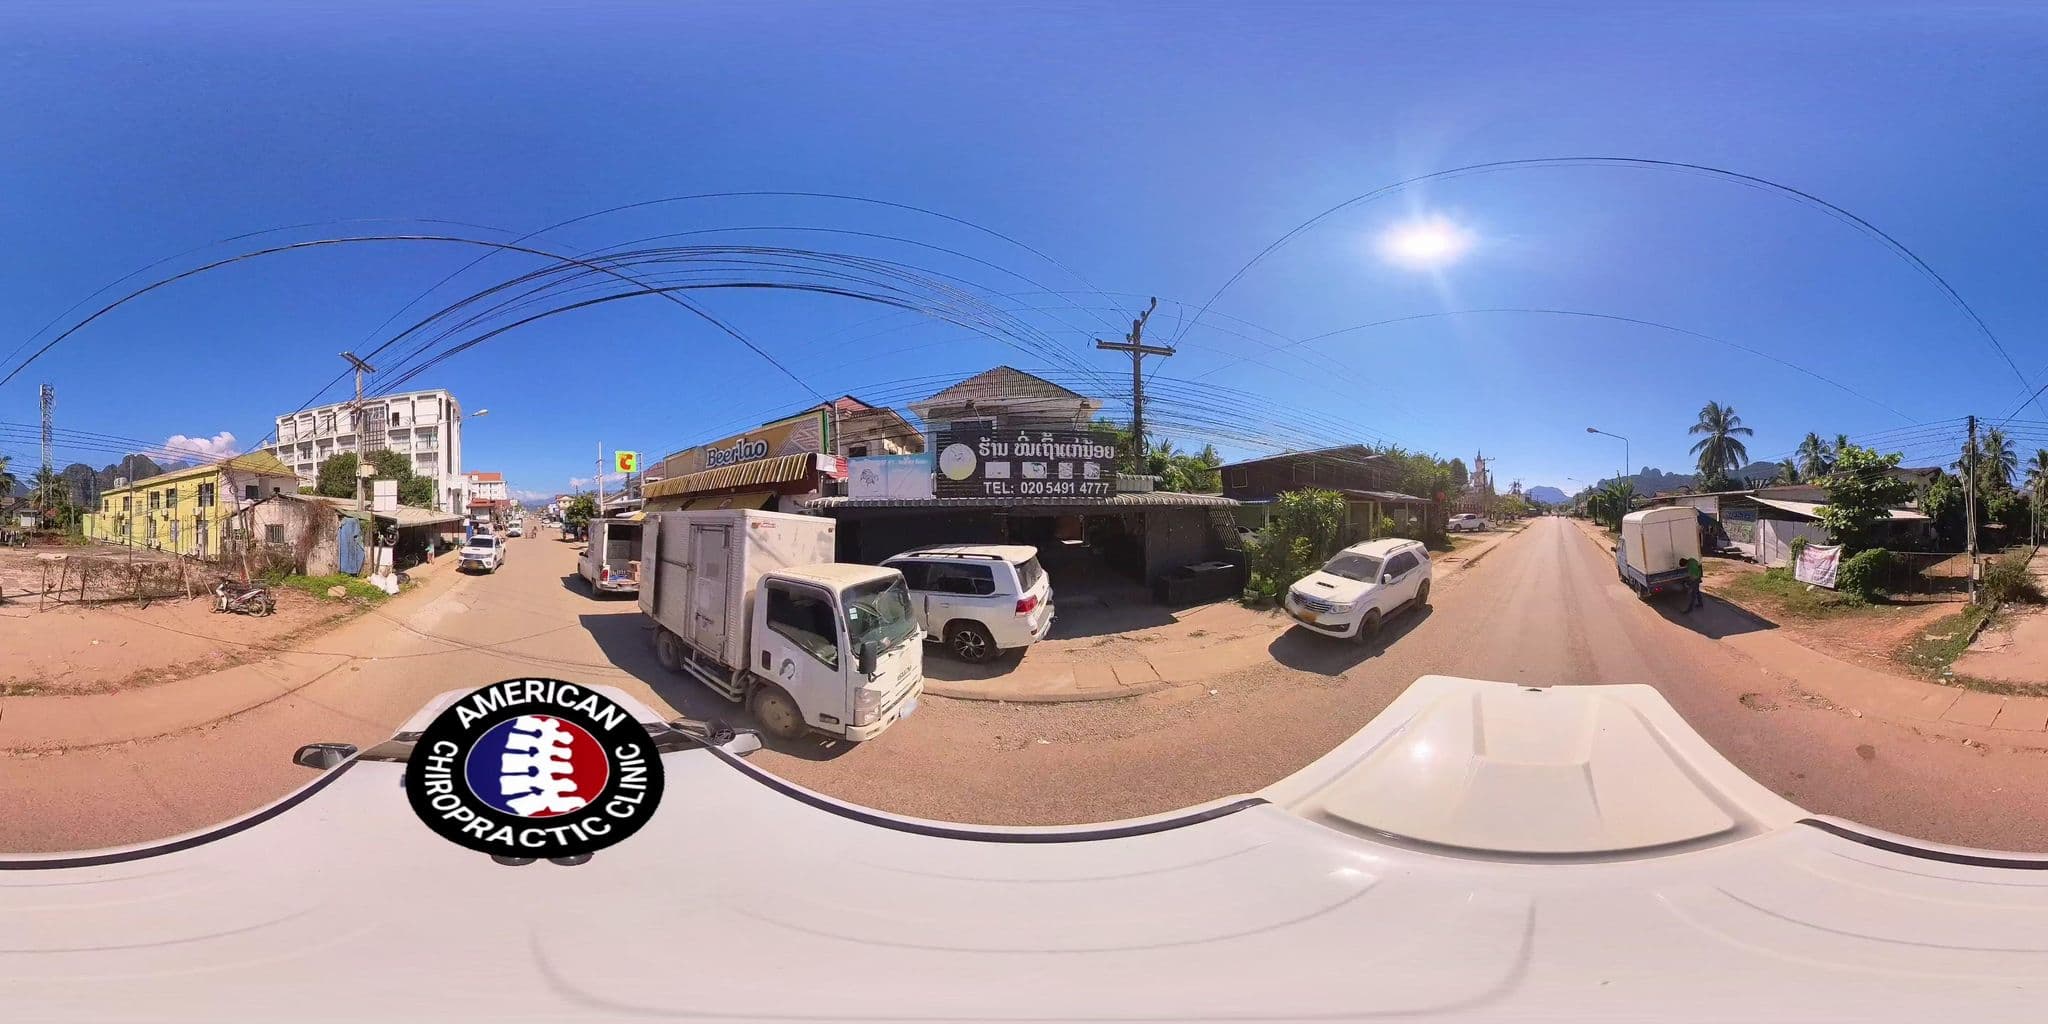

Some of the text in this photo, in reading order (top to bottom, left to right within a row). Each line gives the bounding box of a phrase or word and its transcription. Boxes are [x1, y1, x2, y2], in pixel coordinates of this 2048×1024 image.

[706, 438, 768, 468] Beerlao
[979, 436, 1008, 456] ຮ້ານ
[983, 482, 1109, 494] TEL: 020 5491 4777
